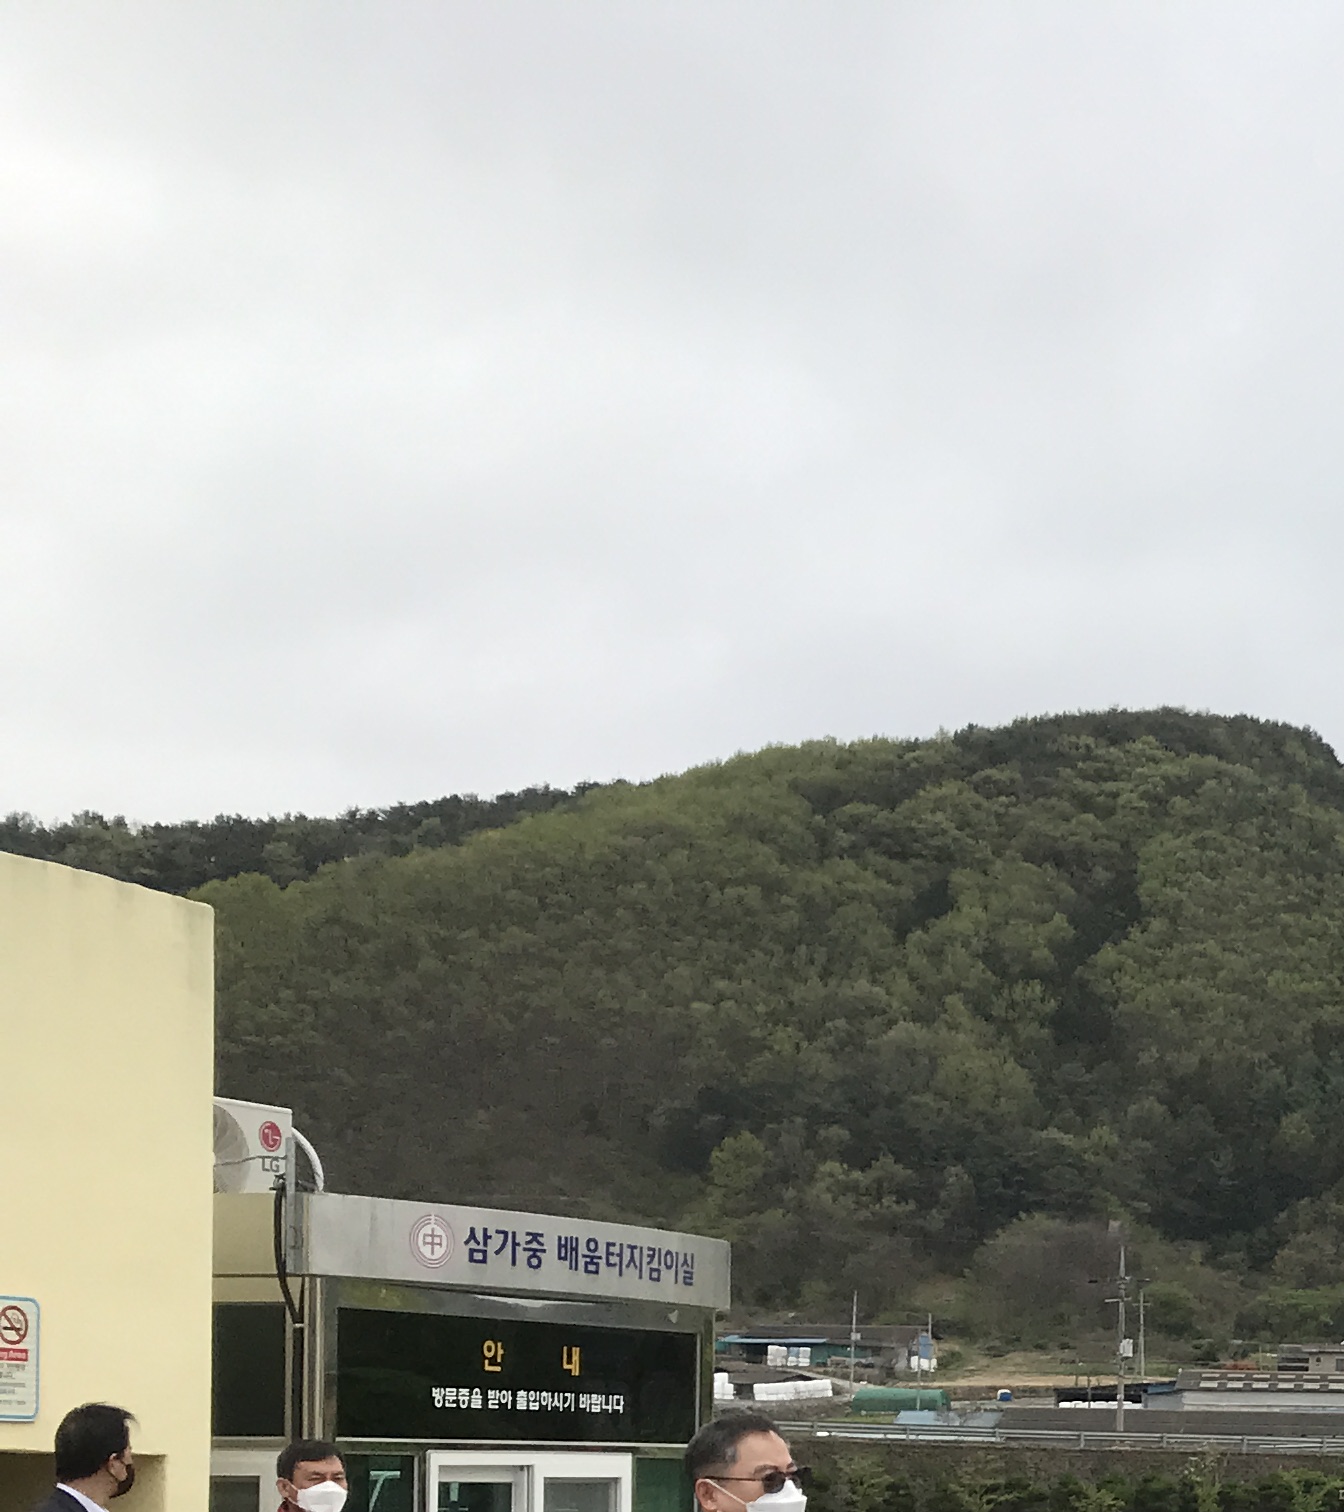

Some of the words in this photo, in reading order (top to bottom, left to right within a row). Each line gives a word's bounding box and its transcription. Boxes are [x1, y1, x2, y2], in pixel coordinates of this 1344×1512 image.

[463, 1226, 547, 1270] 삼가중
[558, 1236, 696, 1287] 배움터지킴이실
[431, 1387, 483, 1409] 방문증을
[487, 1389, 512, 1410] 받아
[516, 1390, 575, 1412] 출입하시기
[579, 1393, 625, 1414] 바랍니다
